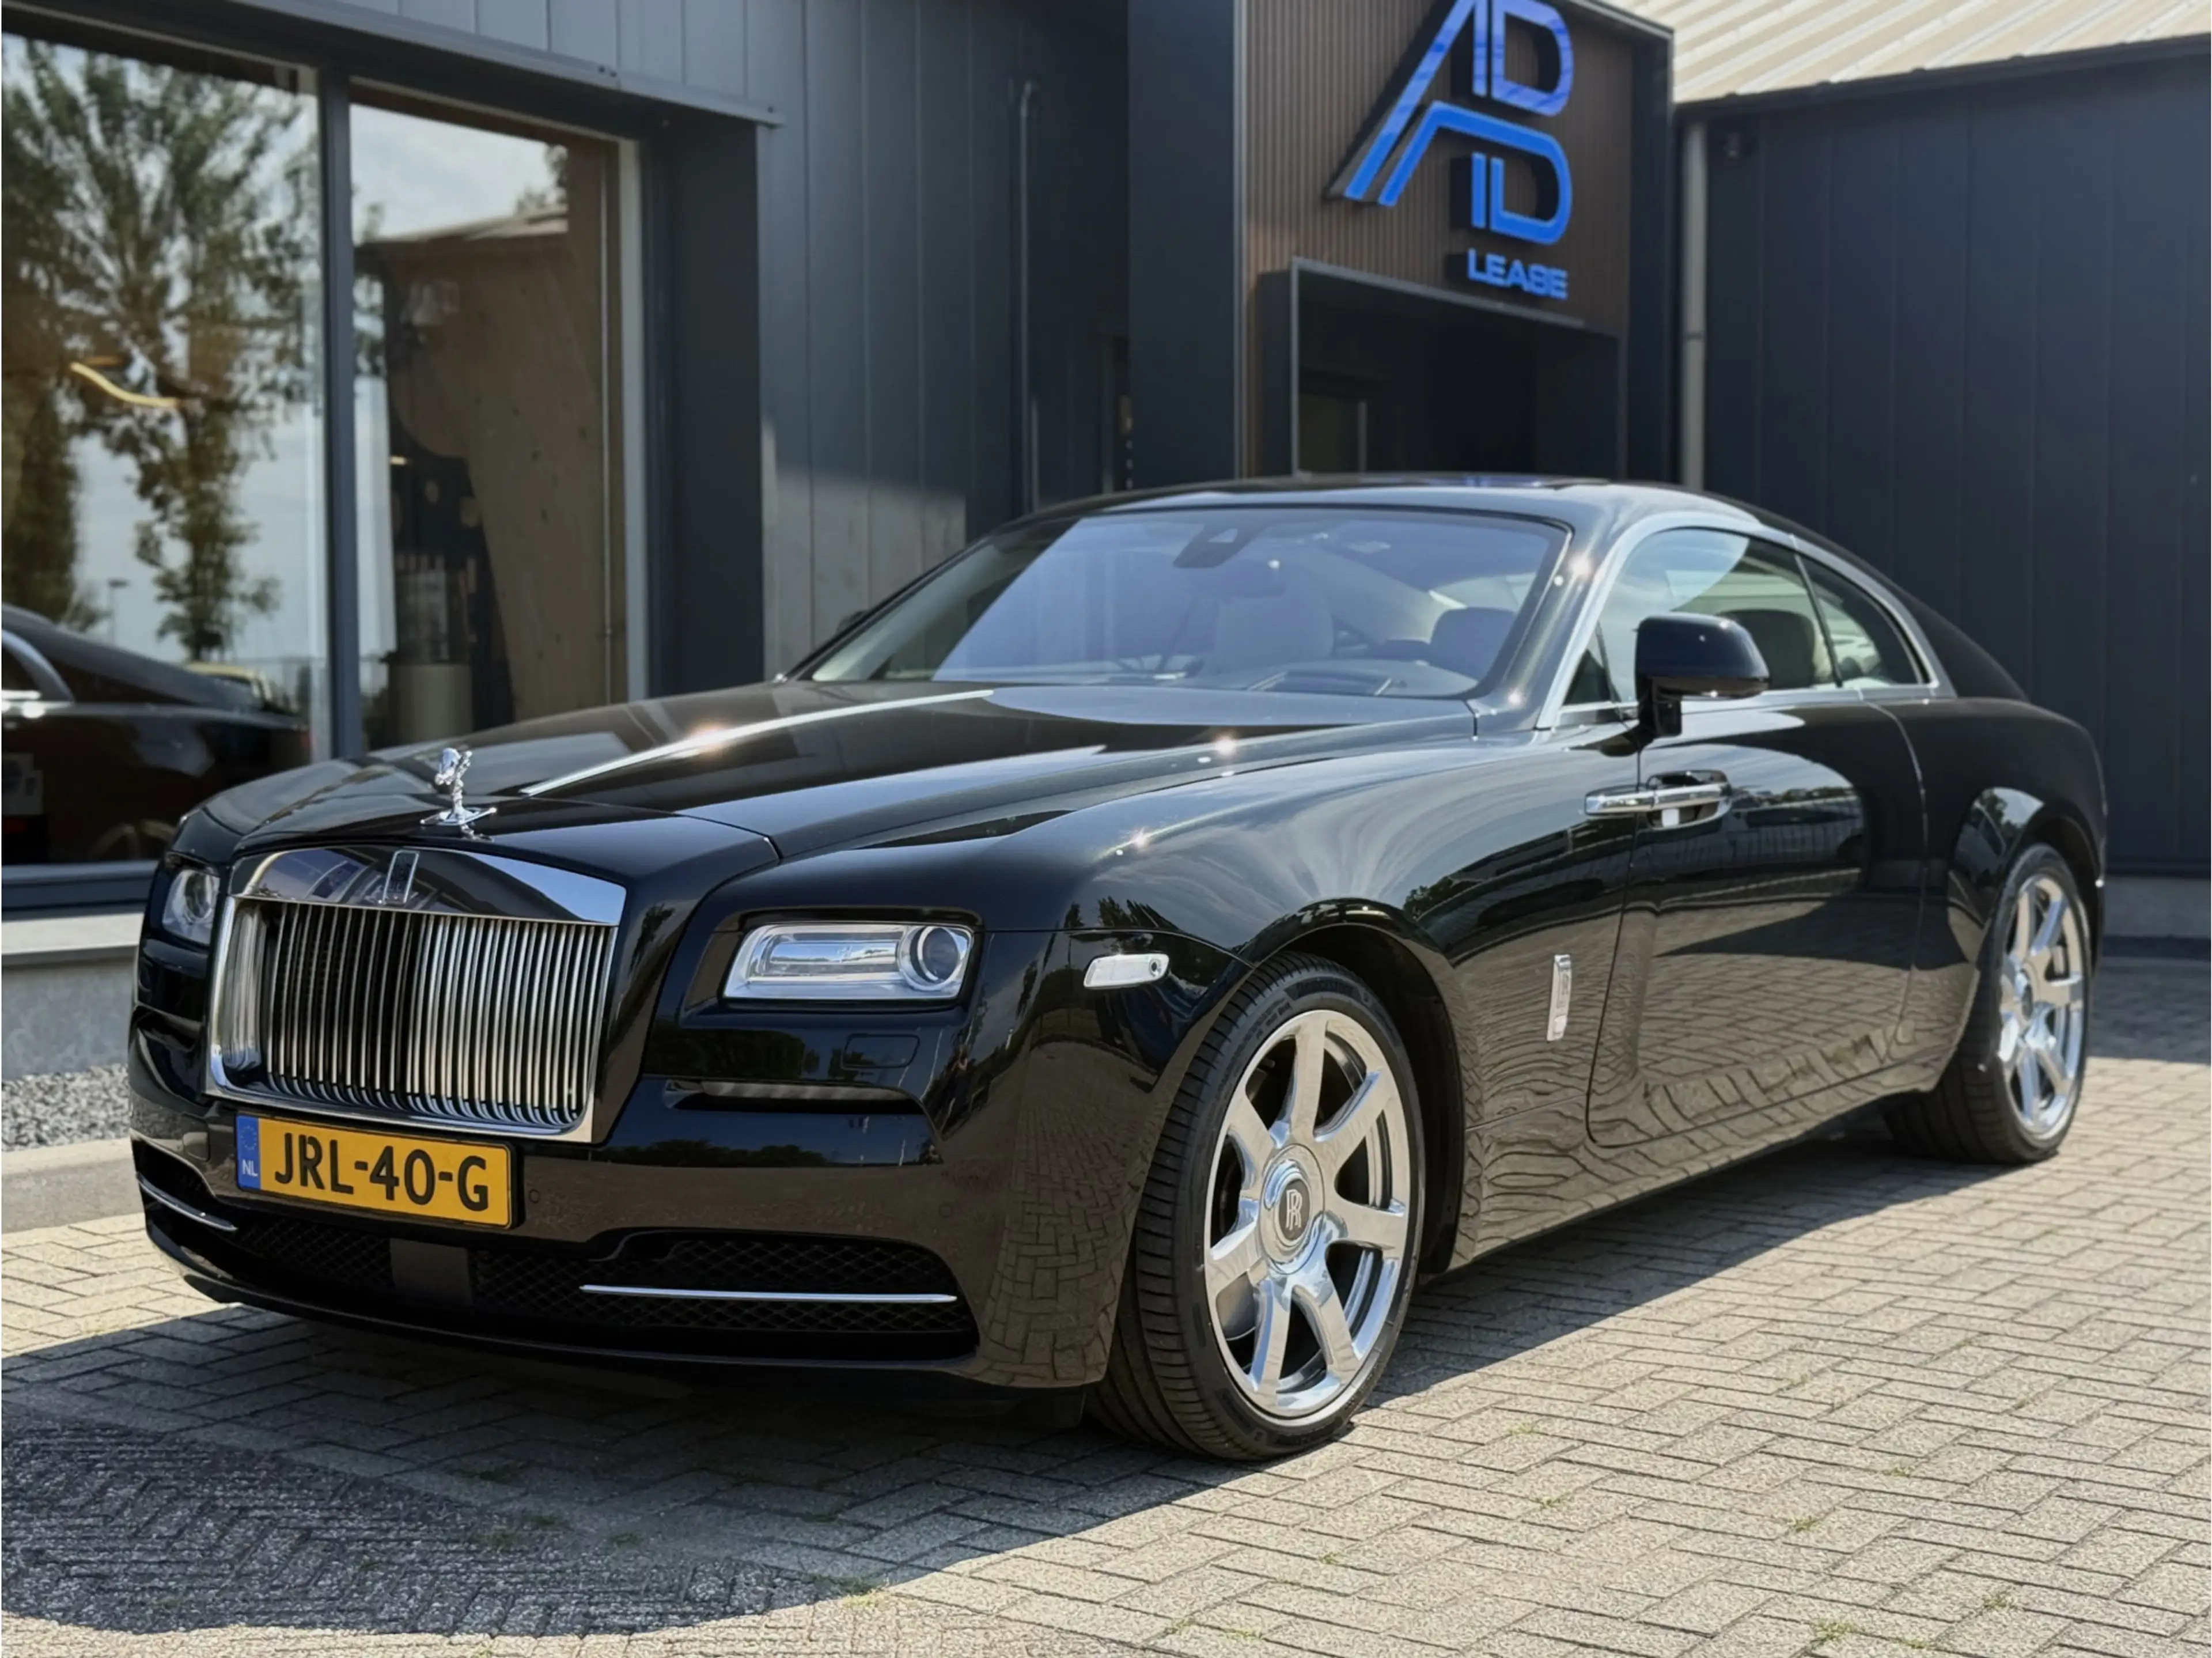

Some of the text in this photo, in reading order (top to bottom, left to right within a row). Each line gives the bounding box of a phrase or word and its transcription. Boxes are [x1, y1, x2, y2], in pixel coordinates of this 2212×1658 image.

[1468, 248, 1568, 300] LEASE
[243, 1159, 258, 1176] NL
[275, 1133, 488, 1212] JRL-40-G
